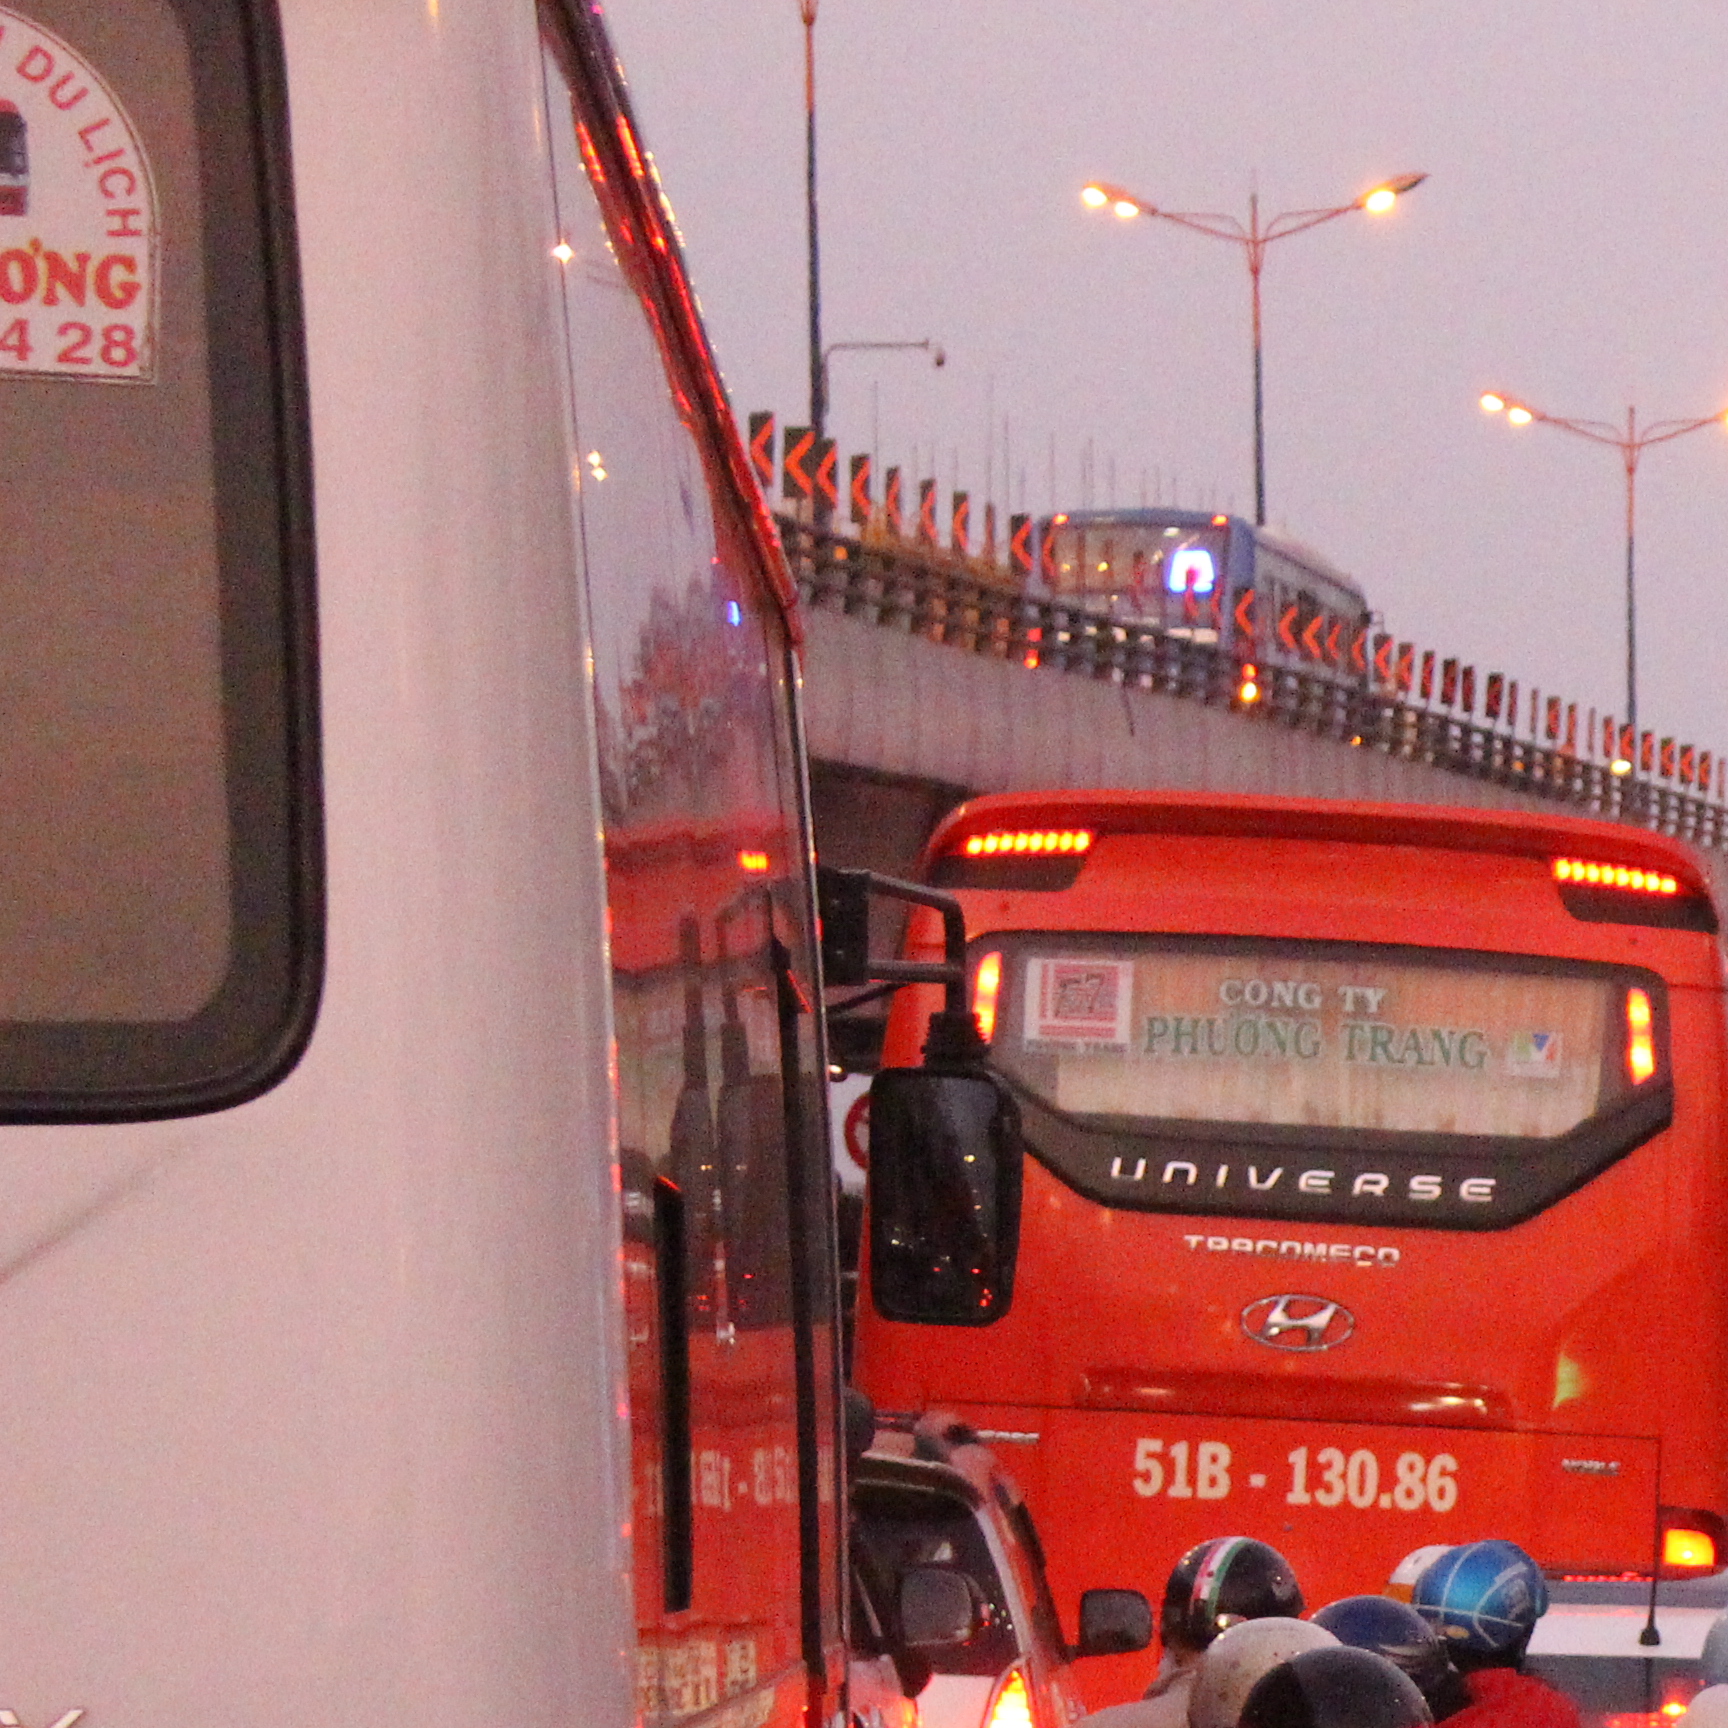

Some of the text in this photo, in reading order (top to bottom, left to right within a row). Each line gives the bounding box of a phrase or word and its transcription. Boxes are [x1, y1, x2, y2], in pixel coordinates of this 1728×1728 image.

[16, 45, 89, 111] DU
[56, 321, 138, 367] 28
[1339, 986, 1387, 1013] TY
[1342, 1022, 1488, 1070] TRANG
[1110, 1157, 1497, 1202] UNIVERSE
[1132, 1438, 1232, 1499] 51B
[1286, 1446, 1459, 1512] 130.86
